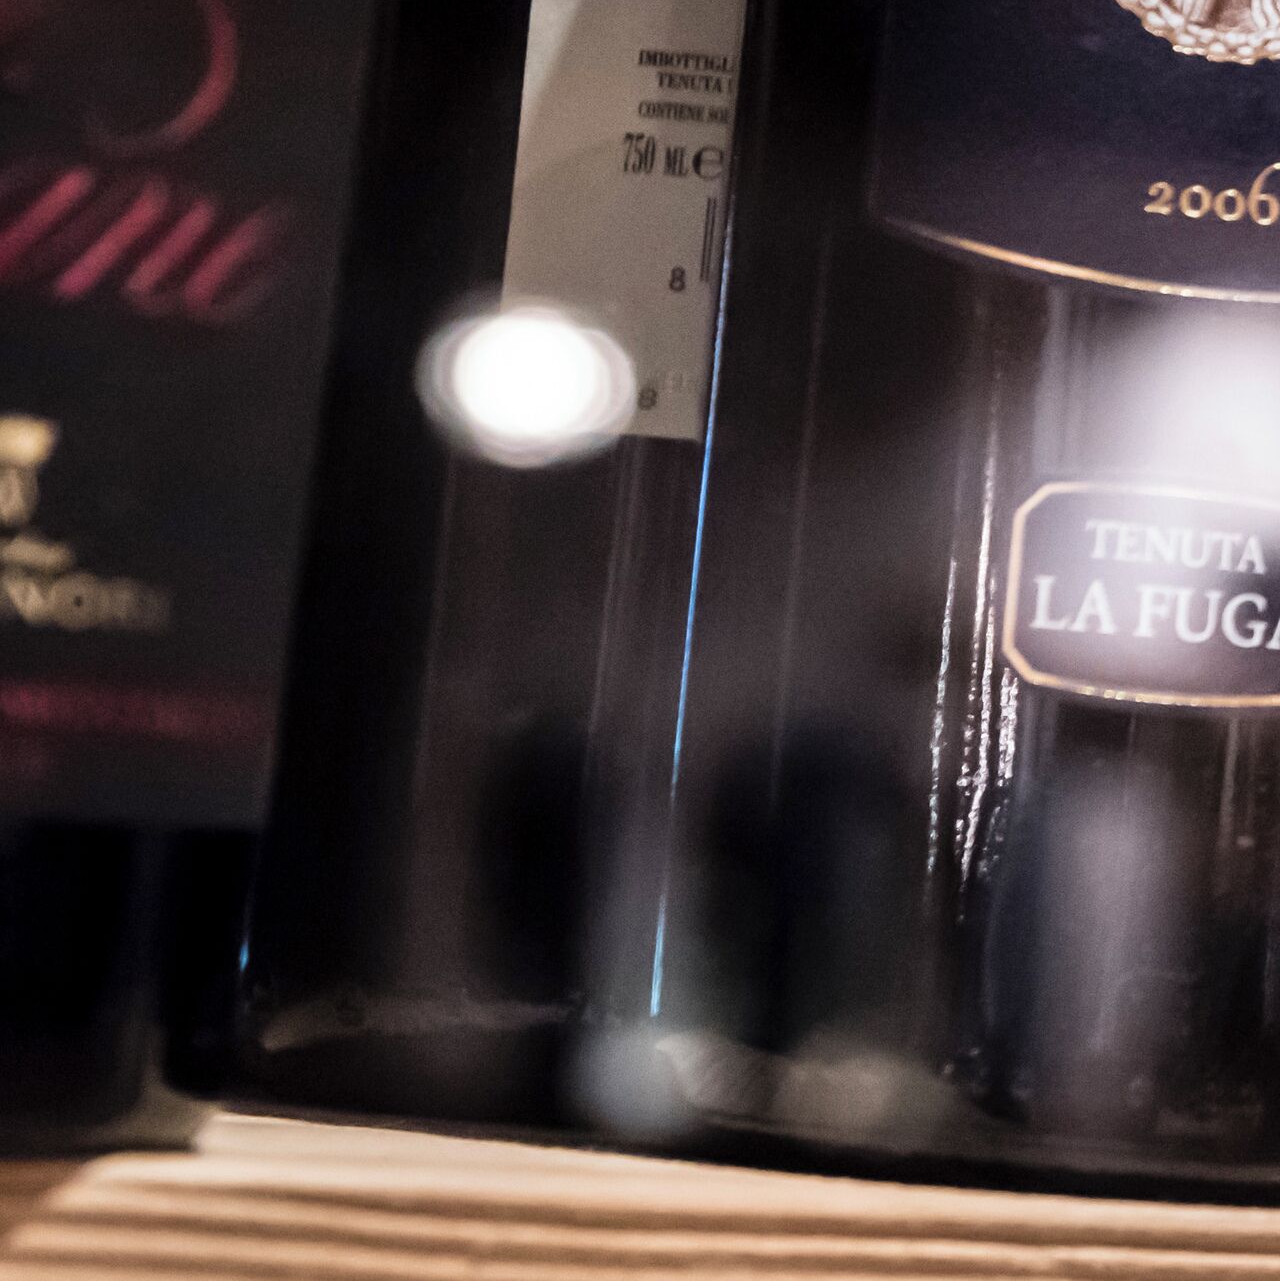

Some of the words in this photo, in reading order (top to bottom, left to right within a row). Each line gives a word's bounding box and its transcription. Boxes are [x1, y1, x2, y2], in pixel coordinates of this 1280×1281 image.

[623, 132, 656, 175] 750
[1086, 520, 1267, 575] TENUTA
[1030, 575, 1119, 636] LA
